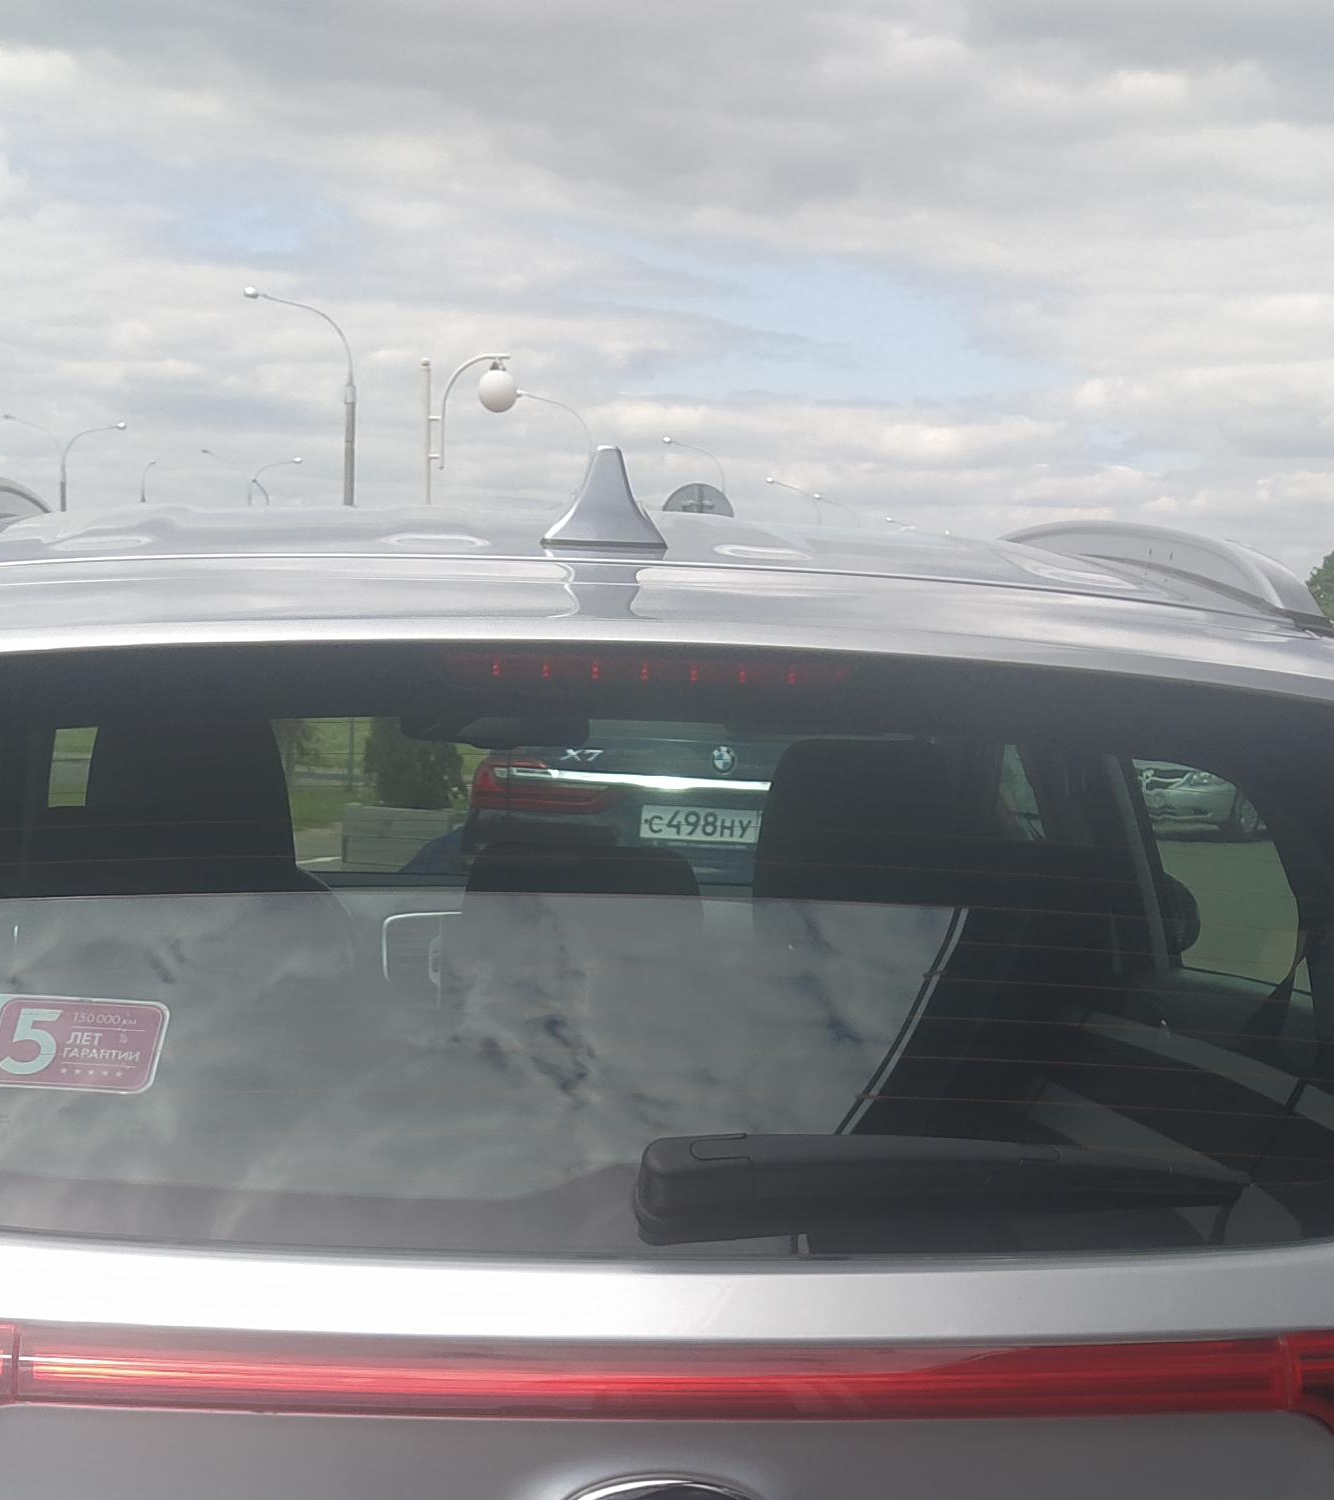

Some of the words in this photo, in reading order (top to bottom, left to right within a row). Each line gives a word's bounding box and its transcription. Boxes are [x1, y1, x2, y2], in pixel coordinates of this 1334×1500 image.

[559, 748, 604, 762] X7
[65, 1031, 103, 1046] ЛЕТ
[62, 1047, 141, 1062] ГАРАНТИИ
